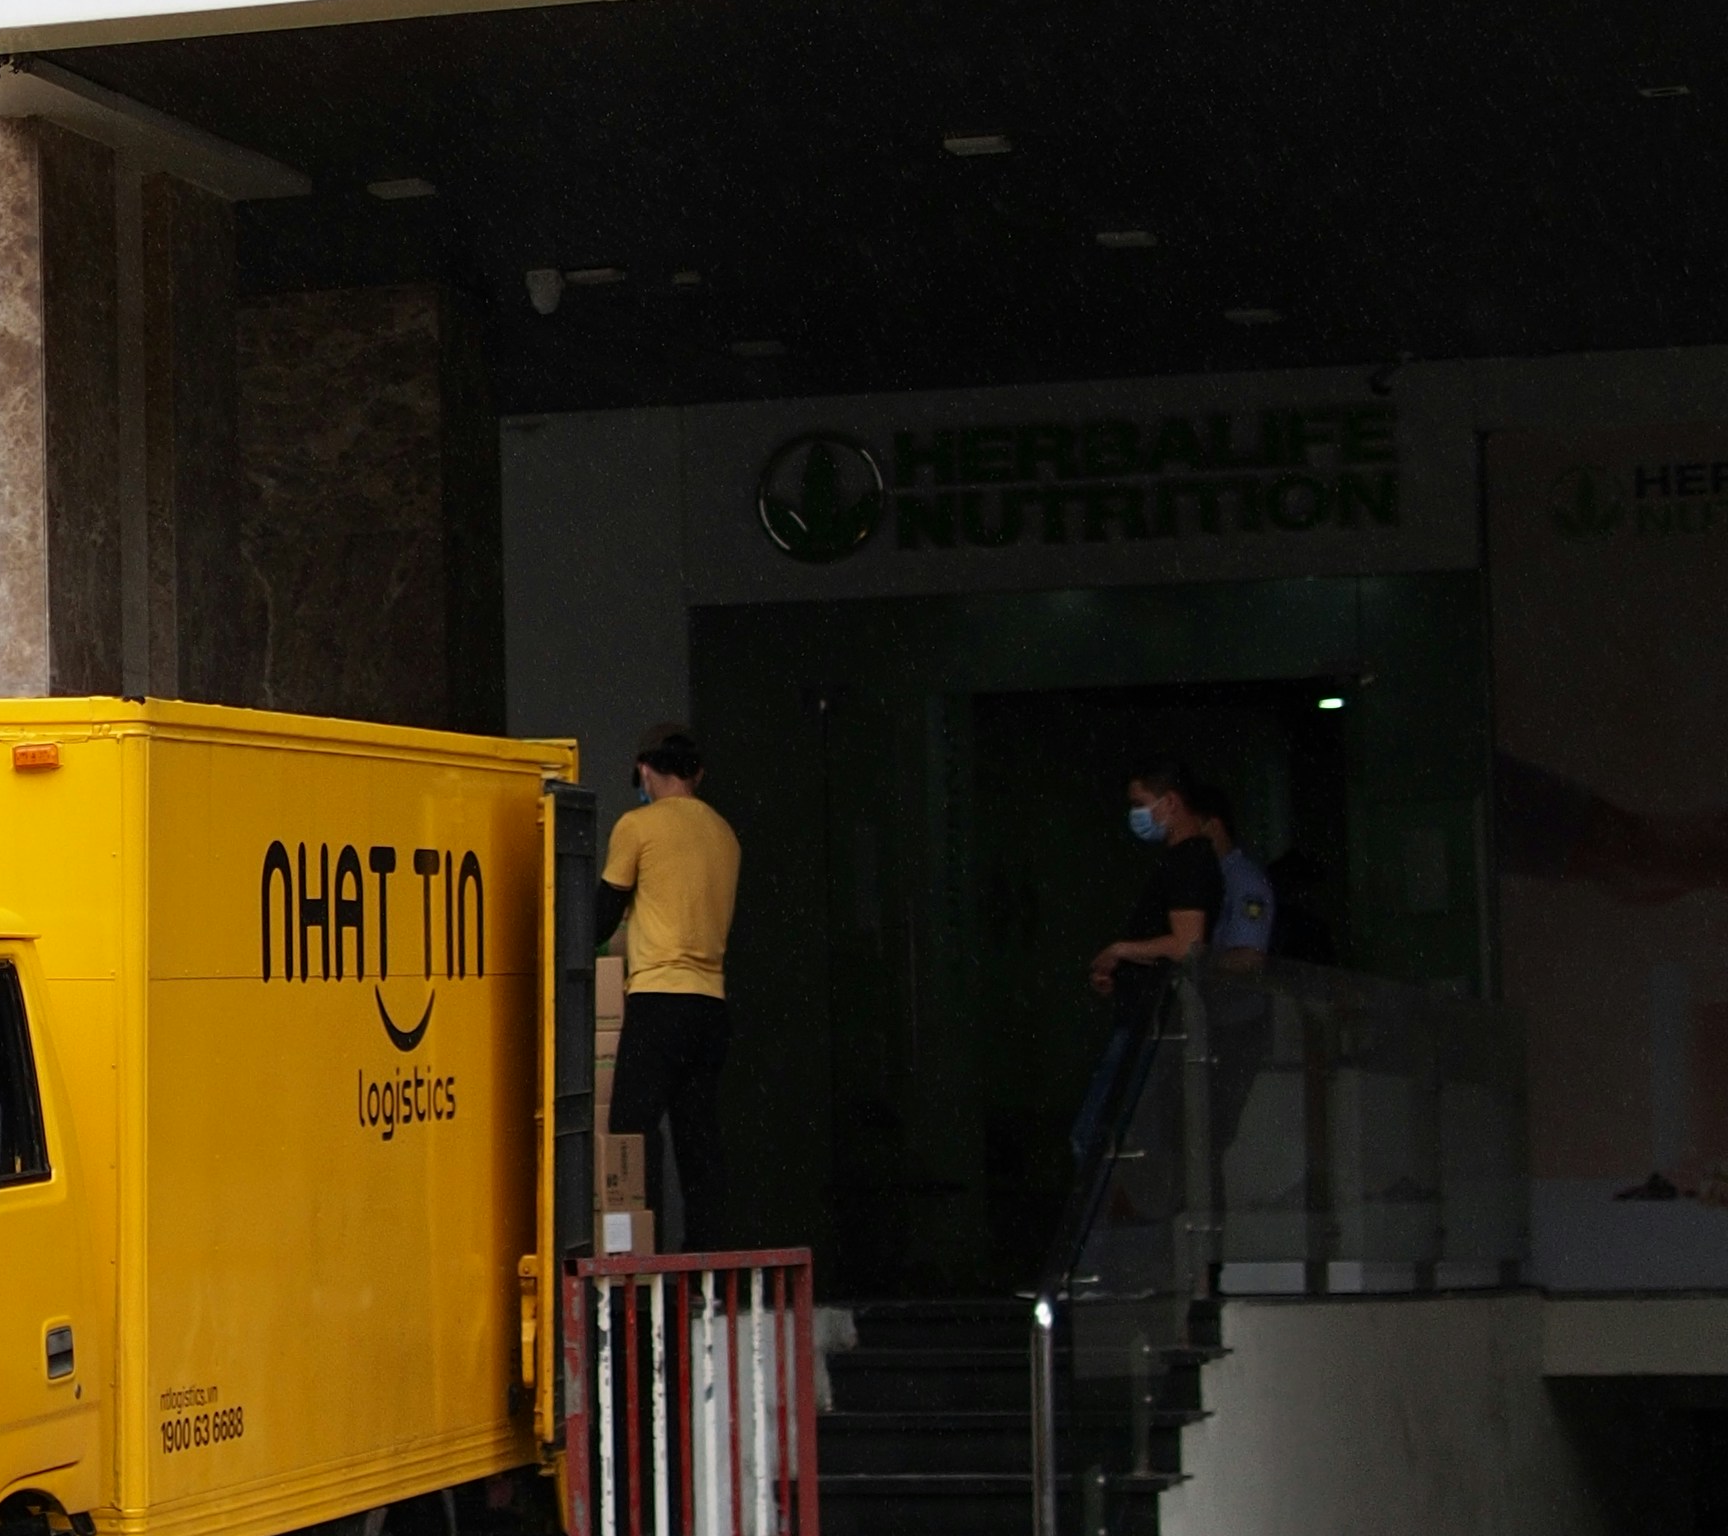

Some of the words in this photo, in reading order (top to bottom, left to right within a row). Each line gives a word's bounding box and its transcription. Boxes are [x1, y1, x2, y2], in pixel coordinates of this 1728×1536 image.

[893, 404, 1399, 489] HERBALIFE
[895, 473, 1399, 551] NUTRITION
[358, 1065, 457, 1142] logistics
[161, 1417, 191, 1455] 1900
[194, 1413, 210, 1447] 63
[213, 1406, 244, 1444] 6688
